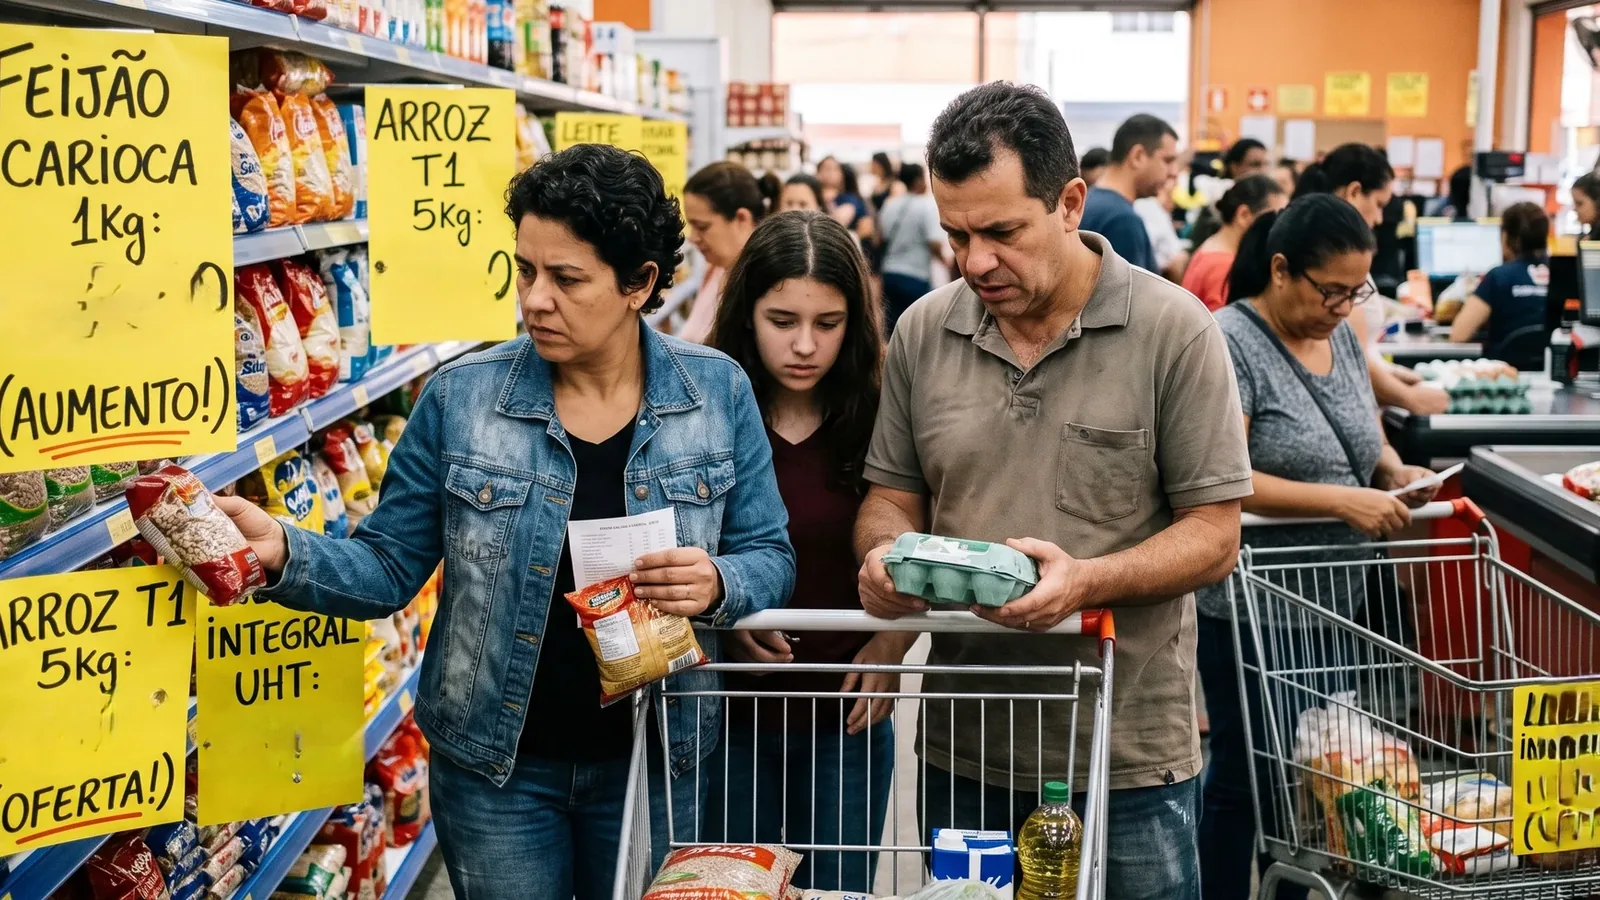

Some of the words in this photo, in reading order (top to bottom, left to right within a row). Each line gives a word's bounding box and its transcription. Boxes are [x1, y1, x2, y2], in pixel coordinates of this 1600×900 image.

[374, 98, 491, 142] ARROZ
[1, 134, 198, 187] CARIOCA
[411, 151, 465, 188] T1
[0, 356, 230, 458] (AUMENTO!)
[135, 573, 190, 626] T1
[235, 660, 320, 706] UHT:
[0, 751, 175, 833] OFERTA!)
